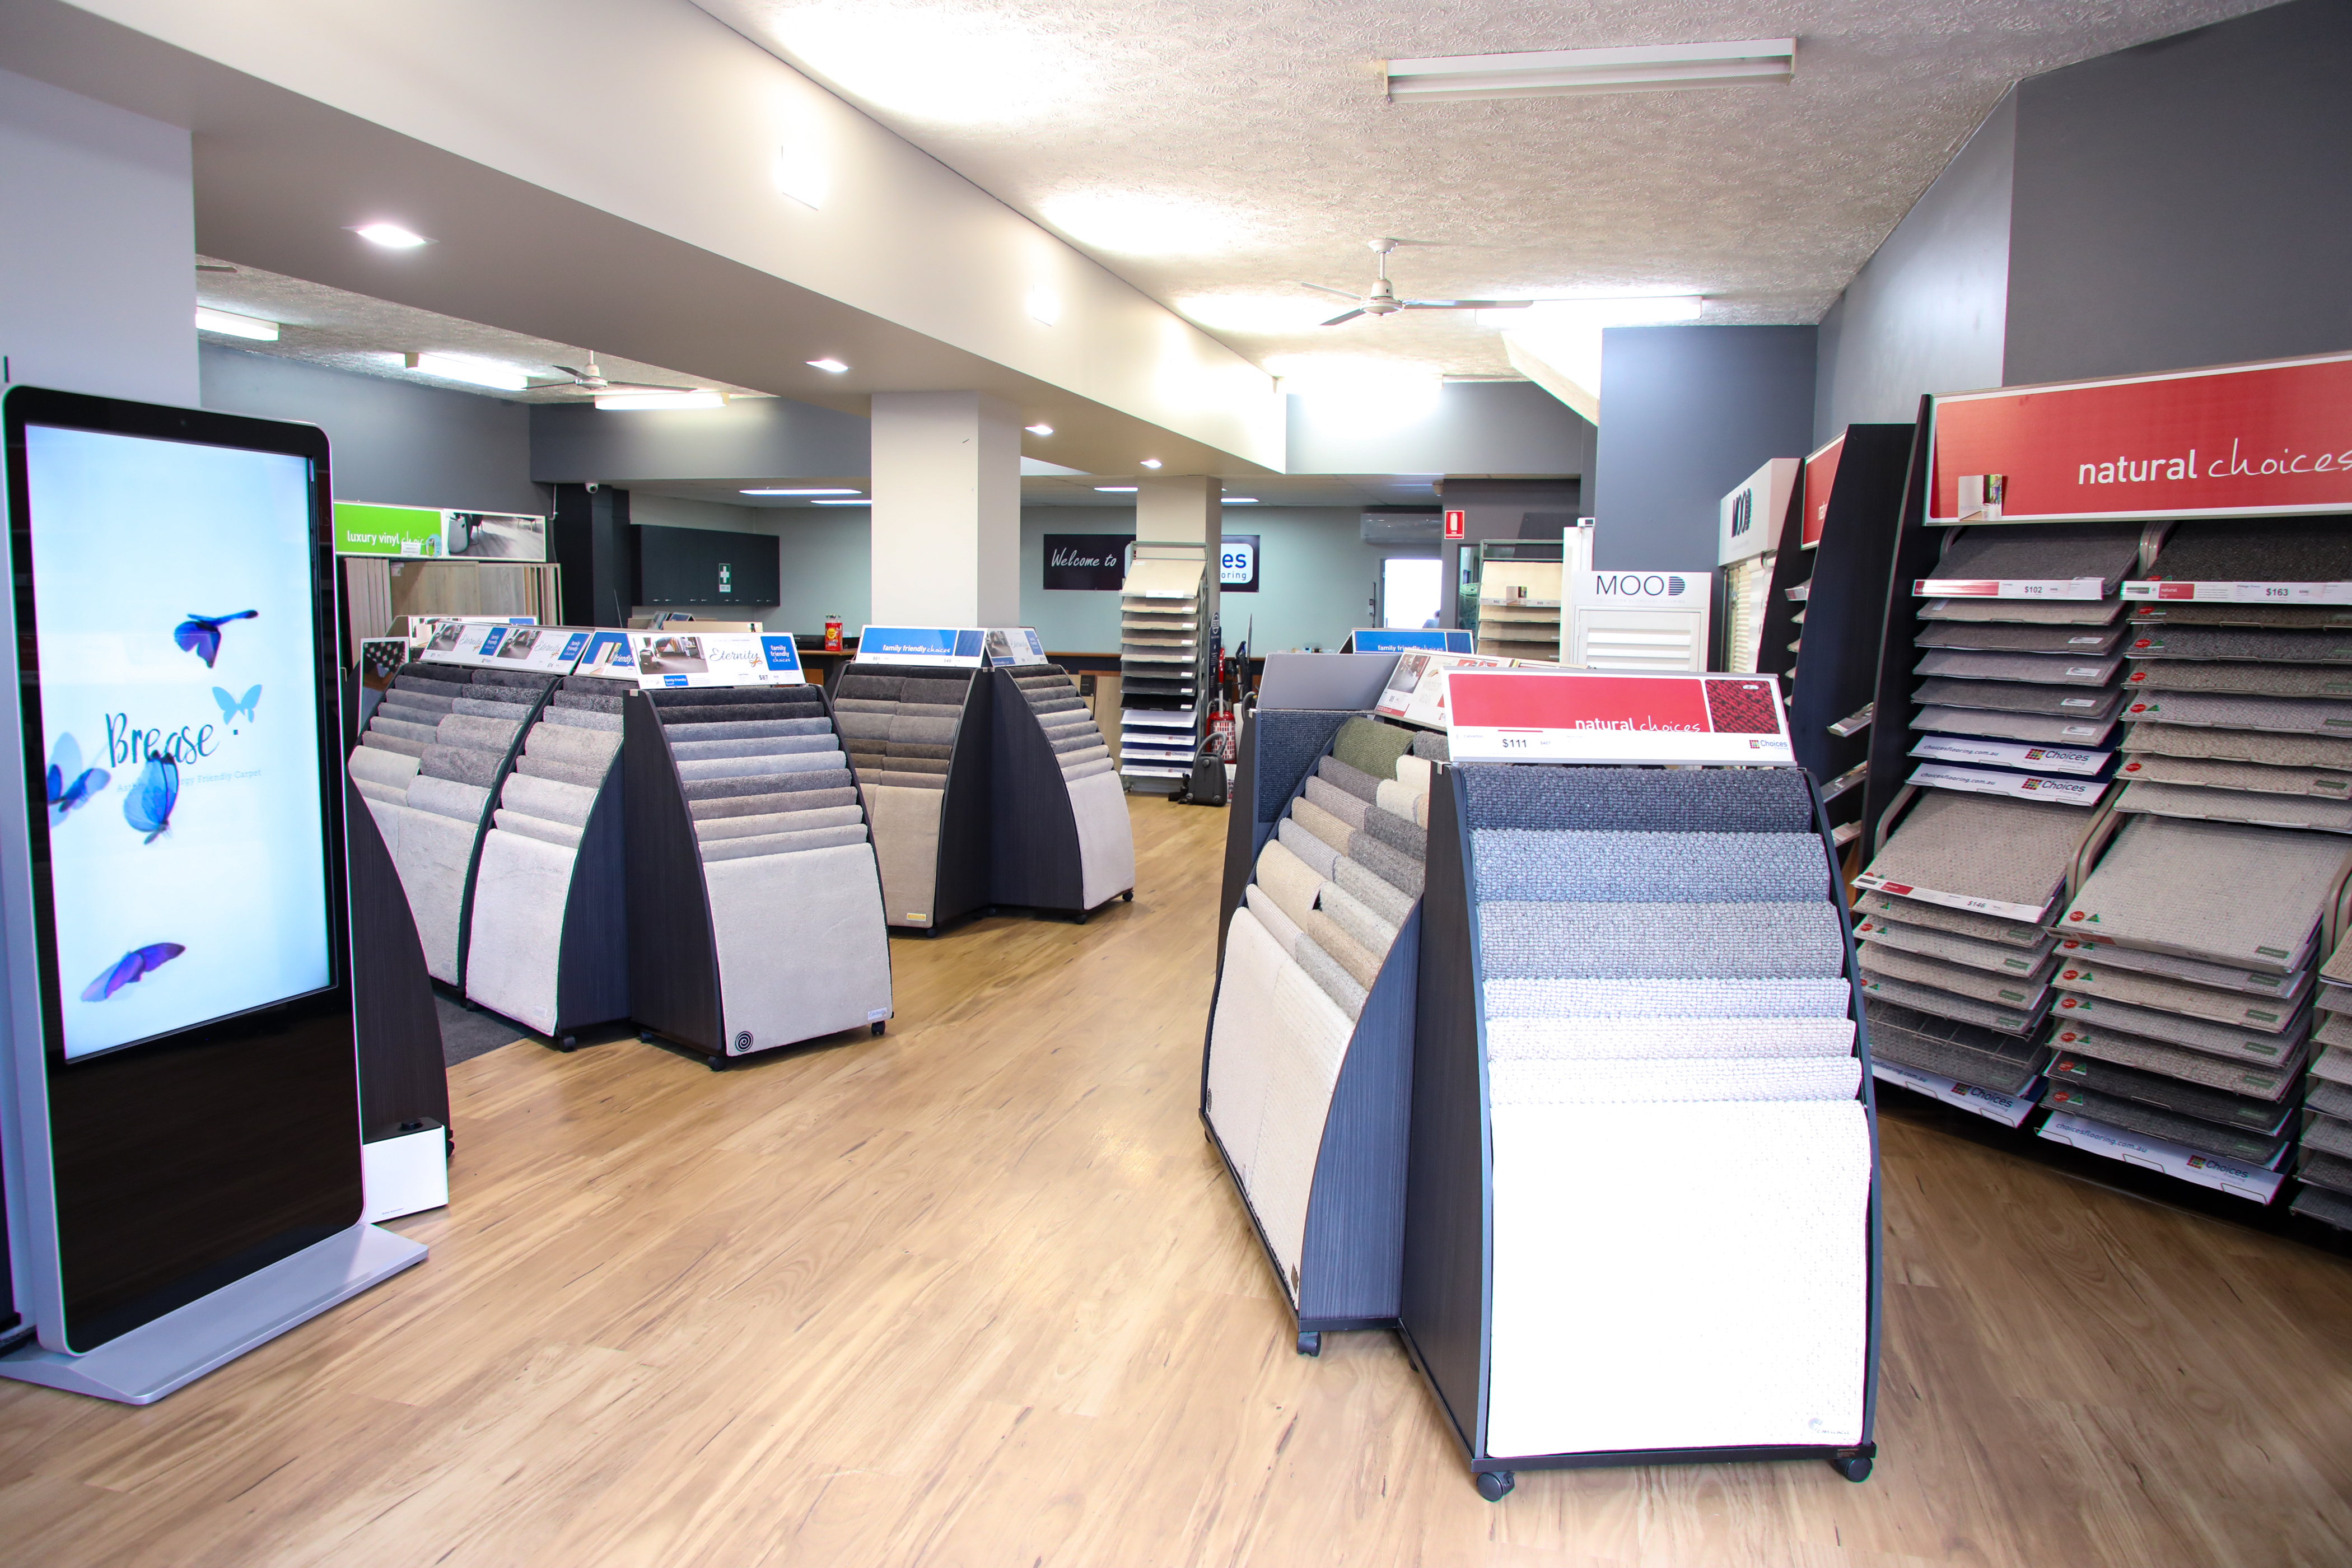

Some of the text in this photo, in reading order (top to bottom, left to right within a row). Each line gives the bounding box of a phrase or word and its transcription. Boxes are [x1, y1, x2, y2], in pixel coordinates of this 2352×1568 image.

[2078, 437, 2352, 485] natural choices
[347, 530, 377, 545] luxury
[379, 532, 399, 547] vinyl
[1051, 547, 1117, 567] Welcome to
[1221, 571, 1247, 581] oring
[1596, 575, 1686, 596] MOOD
[2266, 588, 2289, 596] $163
[534, 641, 562, 651] Eternity
[903, 645, 926, 654] friendly
[927, 645, 951, 653] choices
[615, 654, 632, 664] friendly
[710, 647, 758, 662] Eternity
[1575, 715, 1701, 732] natural choices
[106, 712, 220, 768] Brease
[1502, 739, 1527, 748] $111
[1924, 744, 1999, 756] choicesflooring.com.au
[2045, 750, 2090, 762] Choices
[197, 772, 232, 783] Friendly
[235, 769, 262, 779] Carpet
[1921, 772, 1996, 785] choicesflooring.com.au
[2042, 781, 2087, 792] Choices
[1967, 900, 1986, 909] $146
[1971, 1087, 2013, 1108] Choices
[2056, 1122, 2148, 1152] choicesflooring.com.au
[2205, 1160, 2248, 1178] Choices
